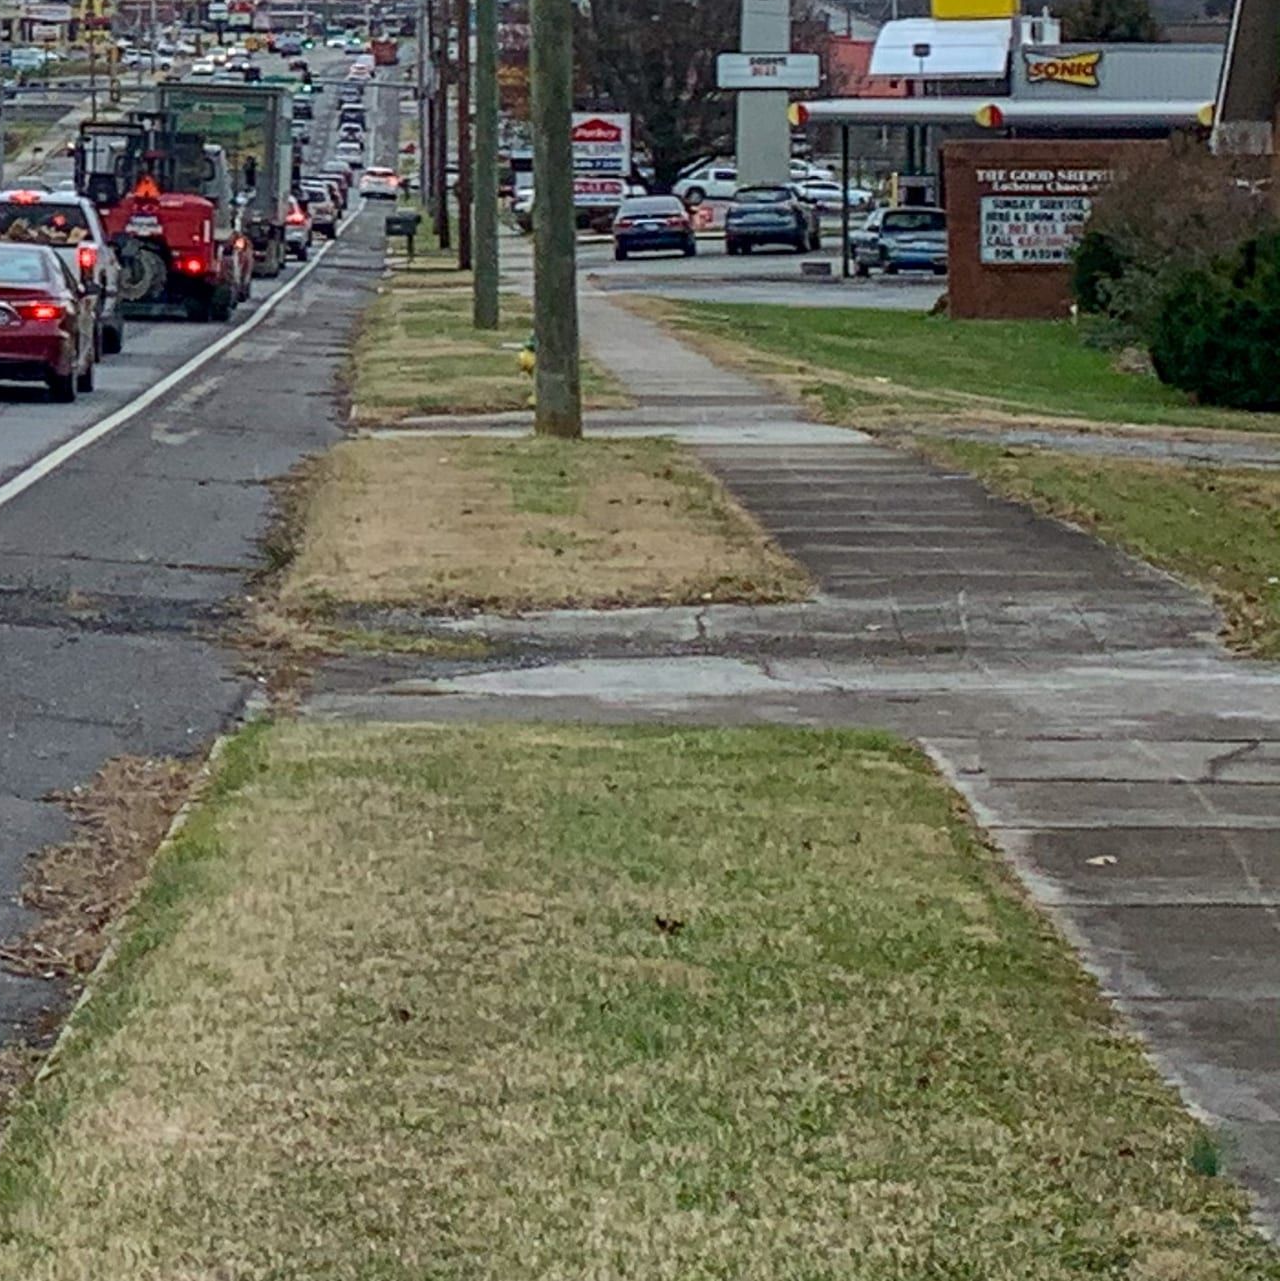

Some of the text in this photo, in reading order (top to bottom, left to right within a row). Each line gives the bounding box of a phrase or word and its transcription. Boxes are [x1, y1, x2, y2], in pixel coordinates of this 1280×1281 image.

[1032, 62, 1094, 77] SONIC
[976, 170, 1007, 182] THE
[1010, 170, 1054, 182] GOOD
[991, 200, 1035, 210] SUNDAY
